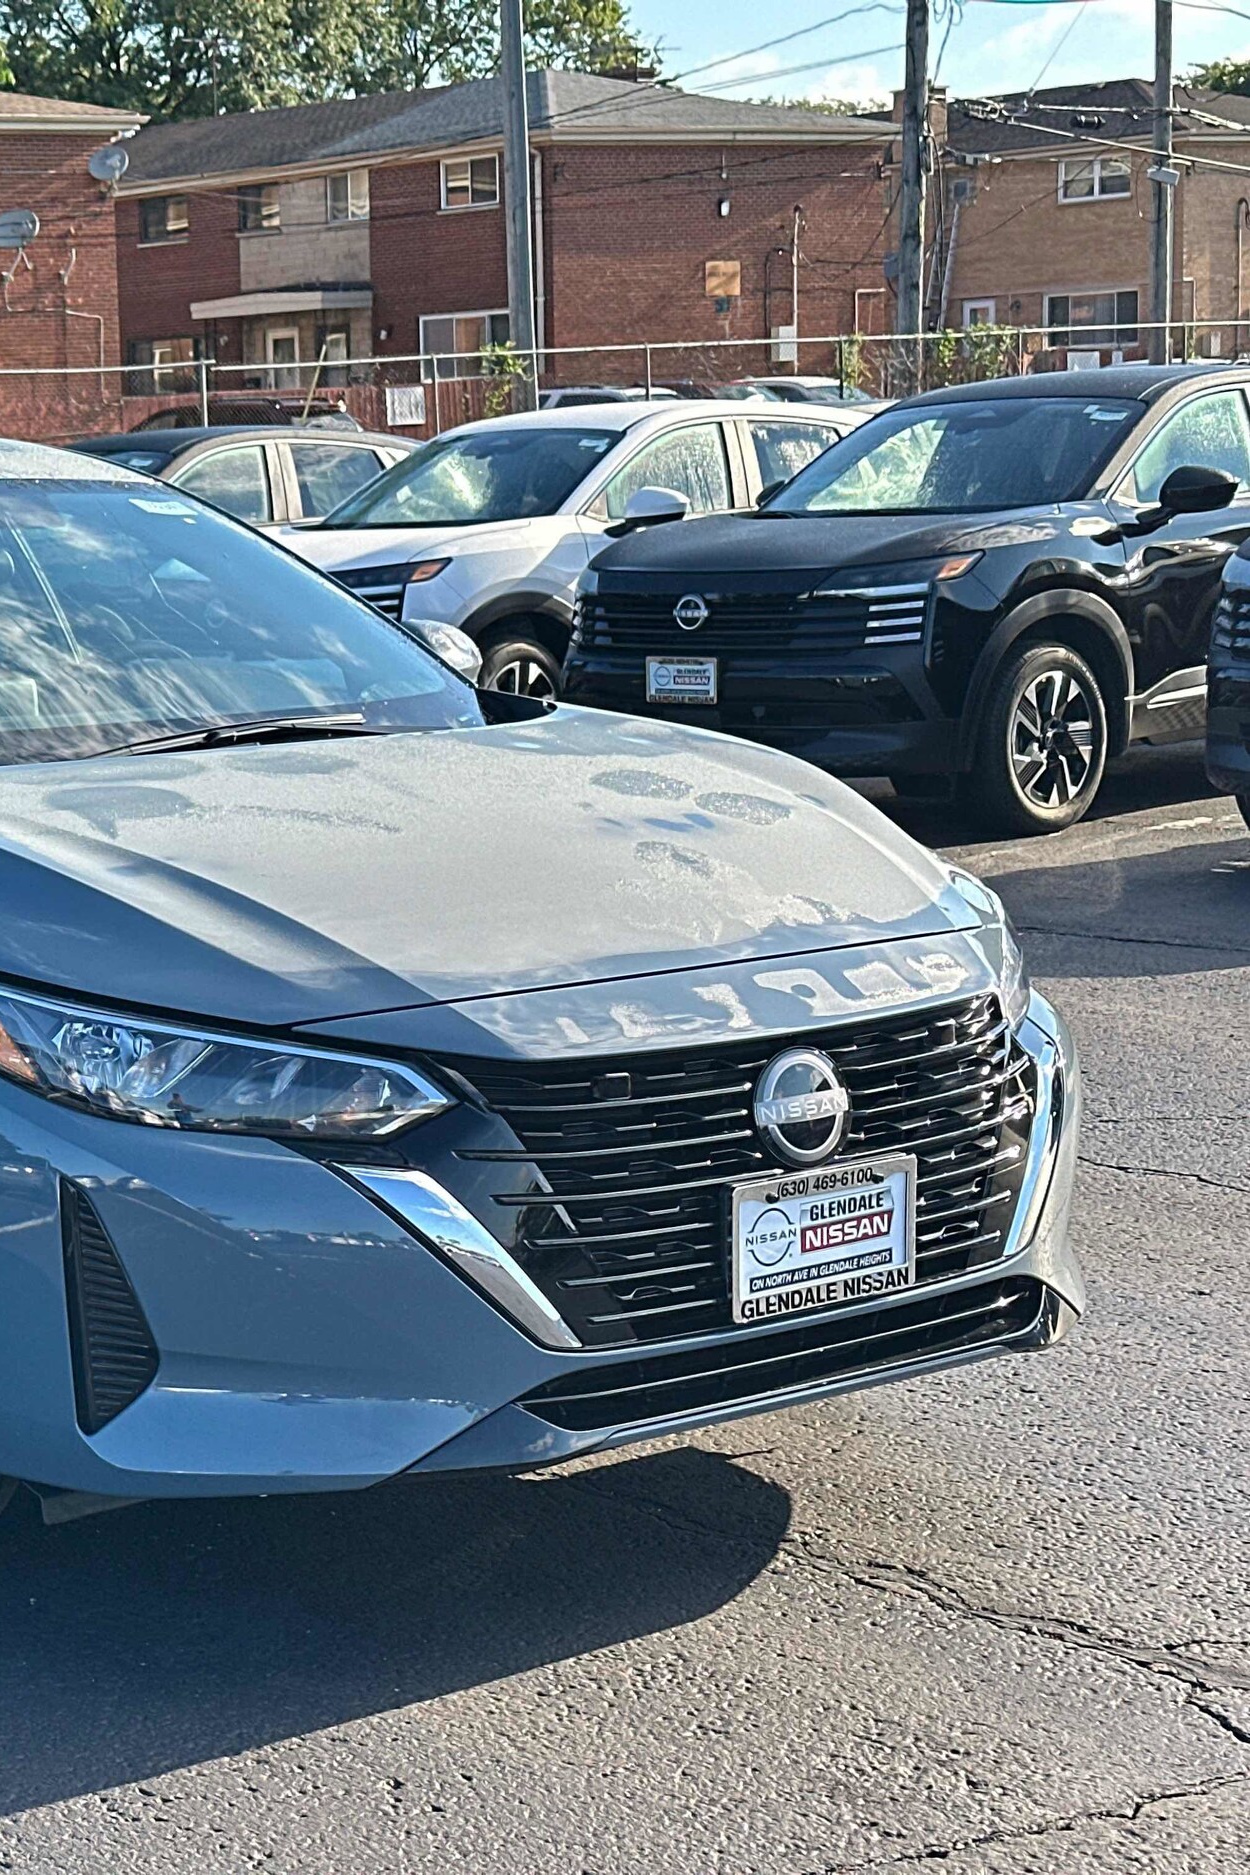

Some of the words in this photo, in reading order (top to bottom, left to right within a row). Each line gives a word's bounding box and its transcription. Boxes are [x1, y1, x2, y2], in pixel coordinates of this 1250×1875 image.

[675, 676, 708, 684] NISSAN
[760, 1096, 846, 1121] NISSAN
[777, 1179, 809, 1198] (630)
[813, 1167, 873, 1191] 469-6100
[810, 1191, 884, 1221] GLENDALE
[745, 1228, 797, 1247] NISSAN
[805, 1213, 888, 1250] NISSAN
[751, 1278, 764, 1291] ON
[765, 1272, 792, 1287] NORTH
[793, 1269, 809, 1281] AVE
[810, 1267, 818, 1278] IN
[820, 1258, 858, 1276] GLENDALE
[859, 1250, 890, 1267] HEIGHTS
[741, 1282, 838, 1319] GLENDALE
[843, 1267, 909, 1298] NISSAN
